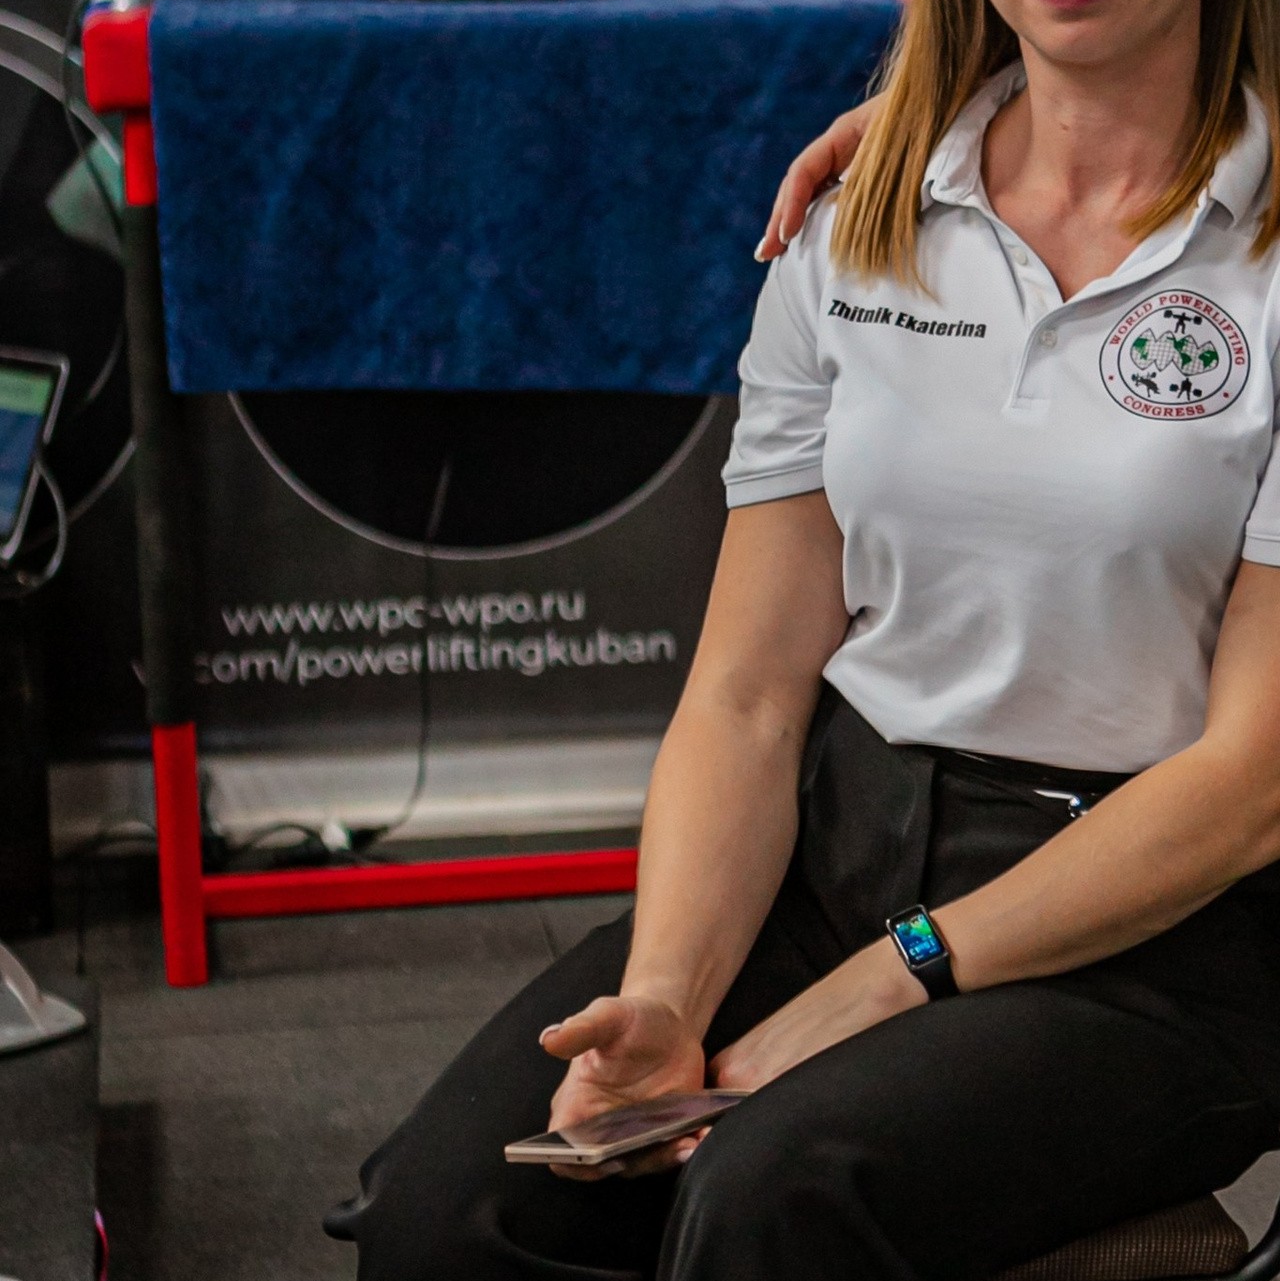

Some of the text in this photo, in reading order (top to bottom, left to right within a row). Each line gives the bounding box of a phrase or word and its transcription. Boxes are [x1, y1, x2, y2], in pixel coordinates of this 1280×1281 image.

[828, 299, 987, 338] Zhitnik Ekaterina
[1109, 294, 1246, 366] WORLD POWERLIFTING
[1123, 395, 1206, 417] CONGRESS
[222, 591, 585, 636] www.wpc-wpo.ru
[132, 629, 676, 684] com/powerliftingkuban
